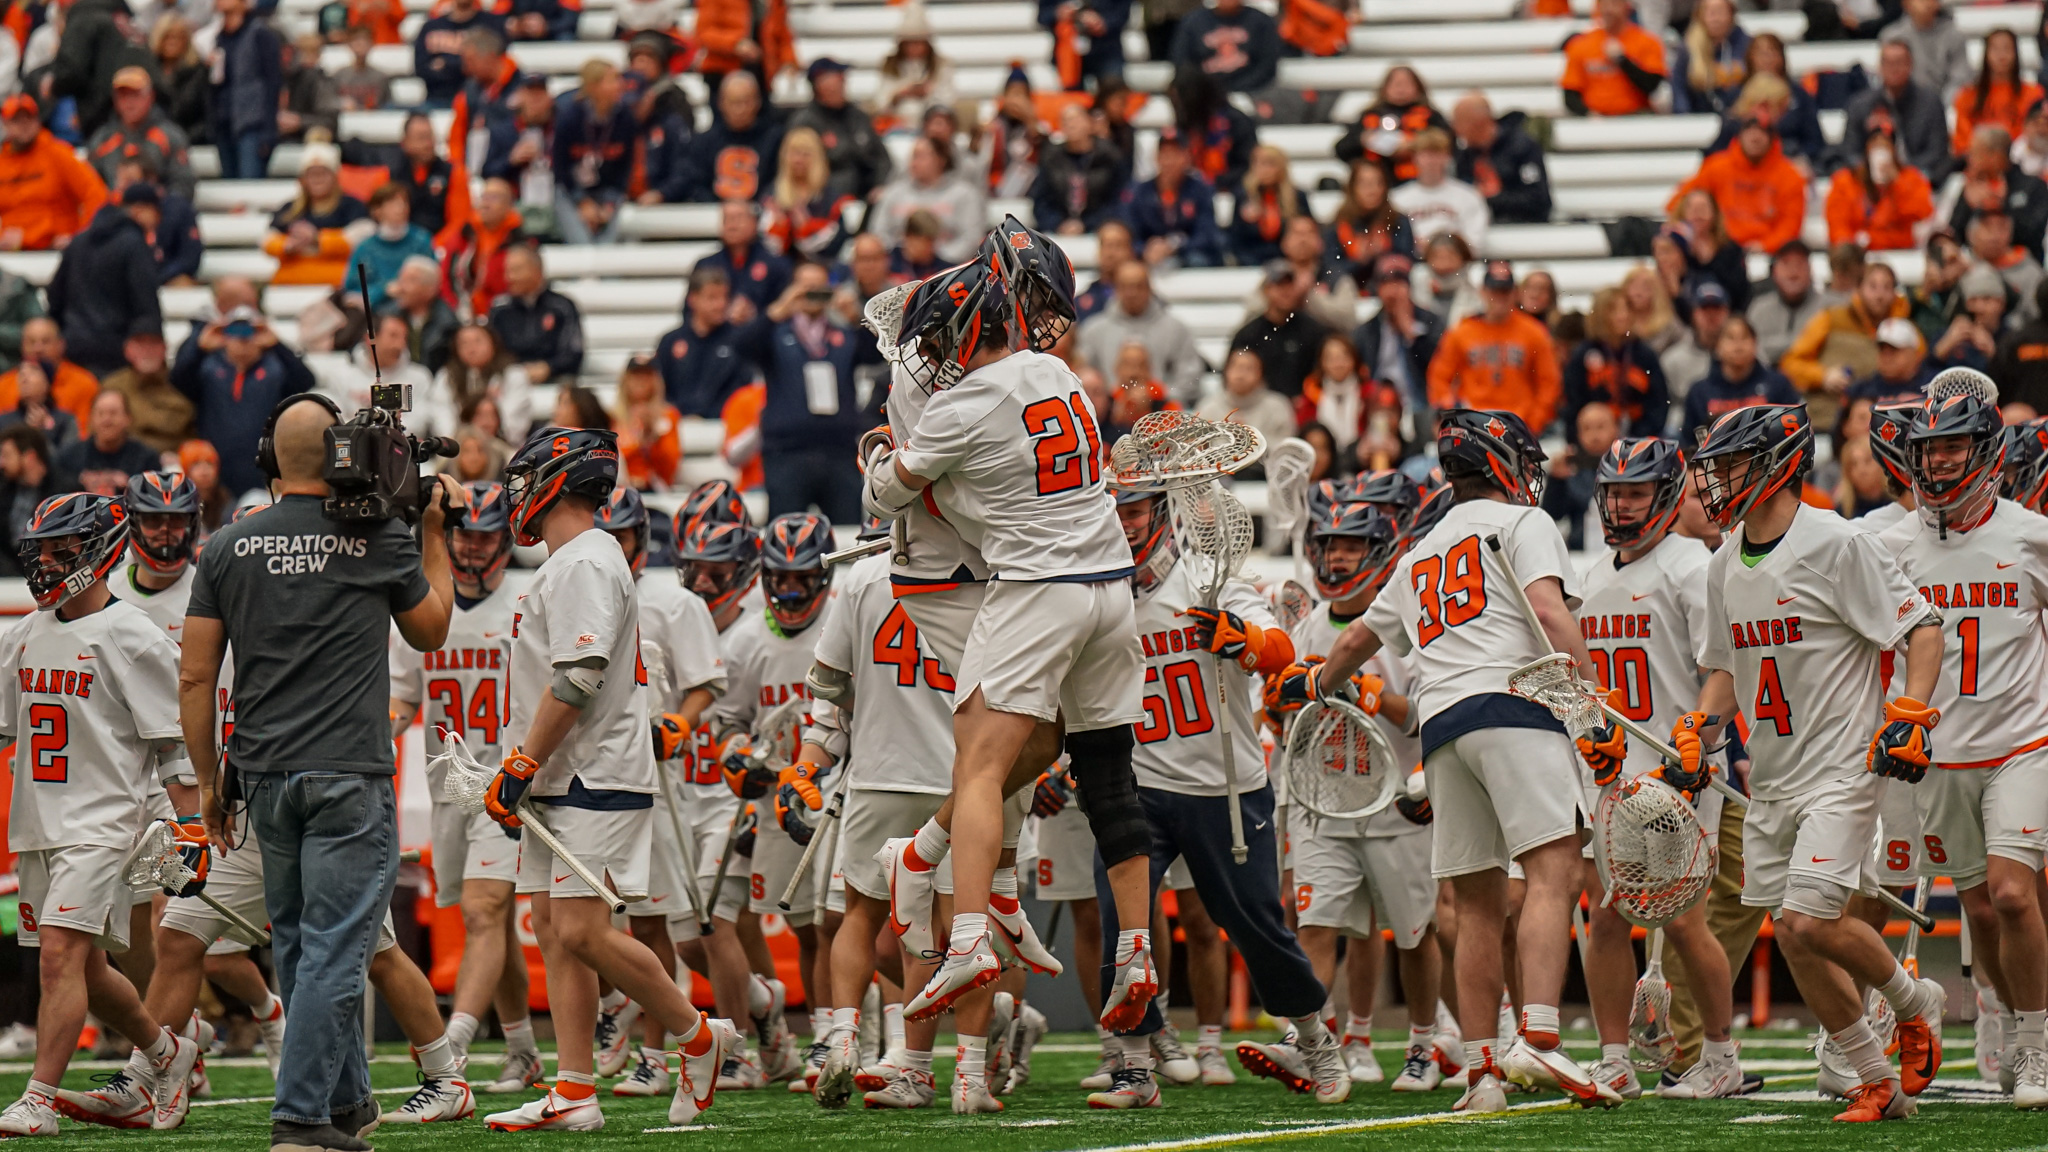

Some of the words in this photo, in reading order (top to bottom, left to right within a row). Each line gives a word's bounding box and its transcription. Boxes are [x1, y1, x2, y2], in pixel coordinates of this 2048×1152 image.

[713, 146, 760, 201] S
[947, 281, 969, 307] S
[1780, 413, 1800, 437] S
[551, 436, 570, 458] S
[1022, 391, 1100, 497] 21
[109, 503, 125, 525] S
[234, 534, 367, 558] OPERATIONS
[266, 554, 330, 575] CREW
[66, 567, 95, 596] 315
[1411, 534, 1488, 650] 39
[1897, 597, 1915, 618] ACC
[1580, 614, 1651, 640] ORANGE
[1730, 616, 1802, 650] RANGE
[1141, 626, 1199, 658] ANGE
[424, 648, 501, 672] ORANGE
[1957, 616, 1980, 697] 1
[1133, 659, 1215, 745] 50
[1755, 656, 1794, 738] 4
[428, 678, 500, 745] 34
[1683, 715, 1695, 729] S
[29, 702, 69, 784] 2
[511, 758, 529, 772] G
[1887, 839, 1911, 871] S
[1924, 834, 1948, 864] S
[1038, 858, 1053, 886] S
[751, 873, 766, 900] S
[1296, 884, 1313, 912] S
[18, 902, 38, 933] S
